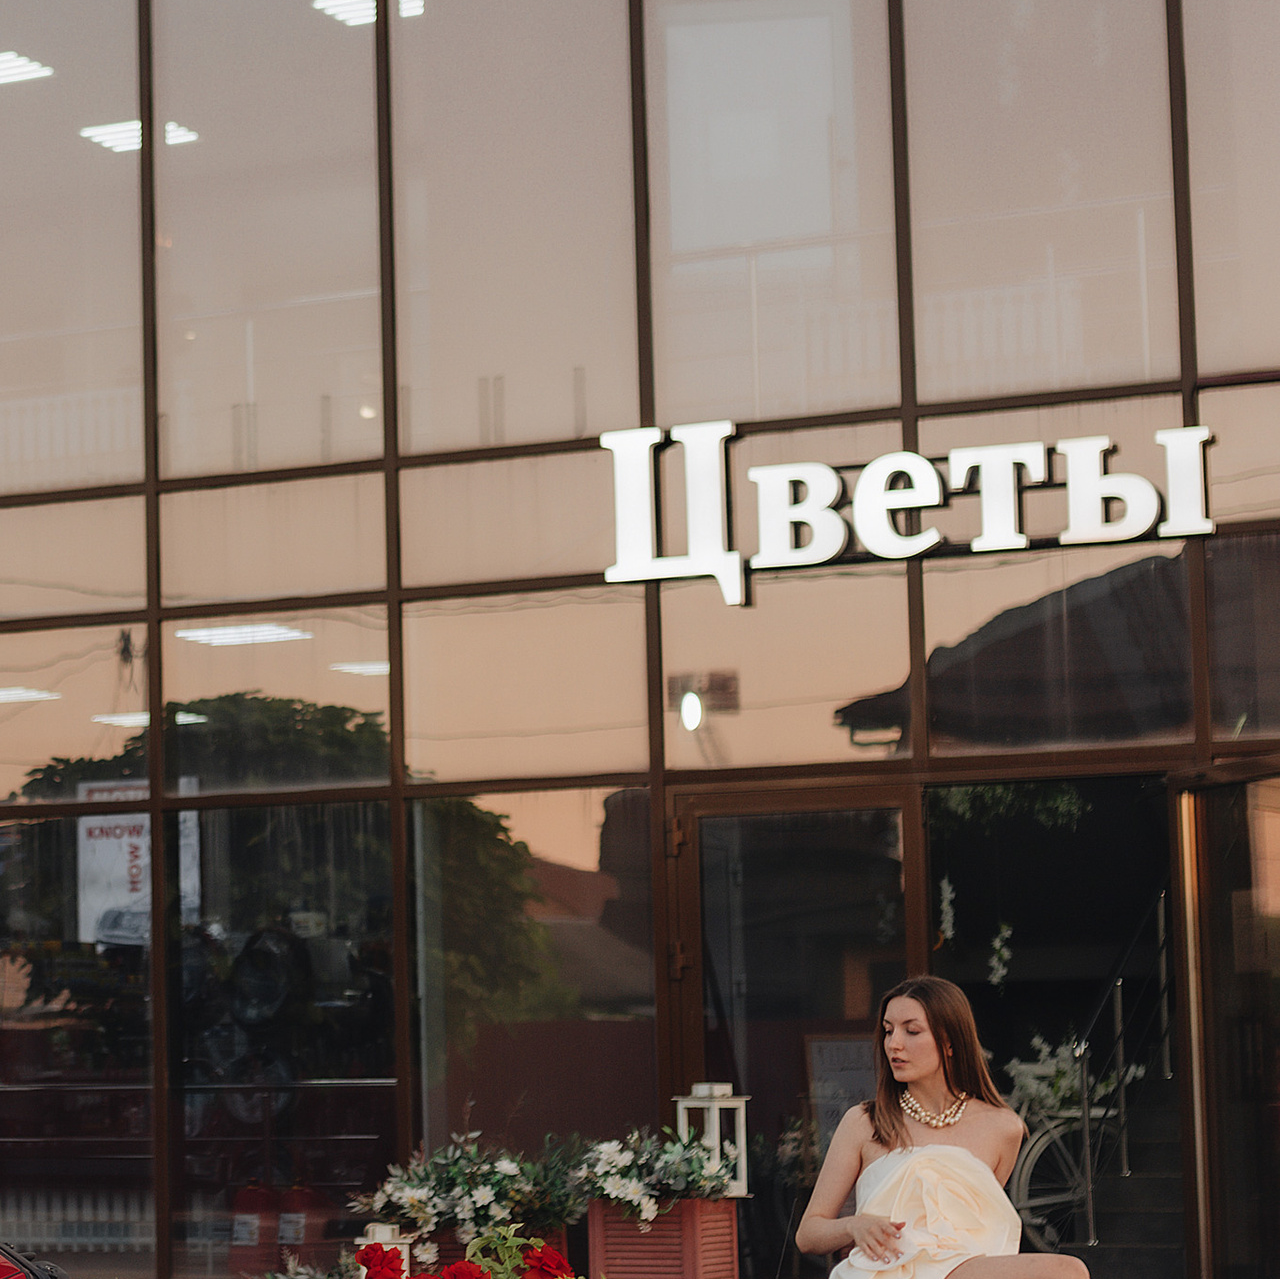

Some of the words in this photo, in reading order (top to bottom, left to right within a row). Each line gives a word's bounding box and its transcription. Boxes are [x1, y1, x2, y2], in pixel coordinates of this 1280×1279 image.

[600, 419, 1216, 607] Цветы
[86, 824, 144, 840] KNOW
[128, 843, 142, 893] HOW
